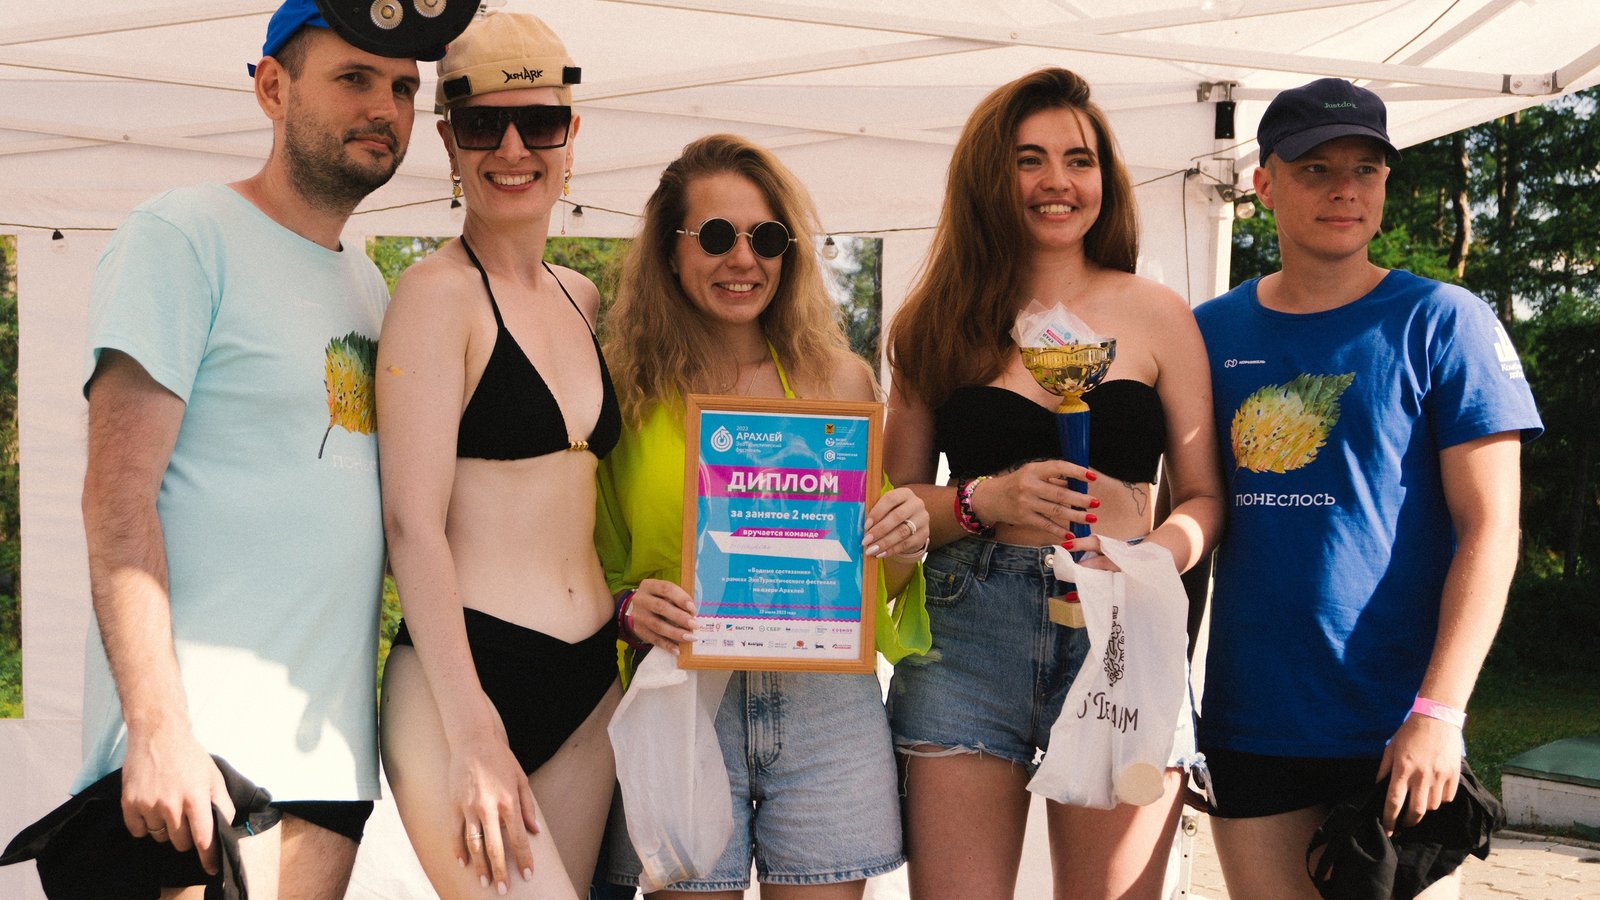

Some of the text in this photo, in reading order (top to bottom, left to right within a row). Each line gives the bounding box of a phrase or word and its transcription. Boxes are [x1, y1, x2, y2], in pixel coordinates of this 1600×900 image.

[736, 432, 783, 442] АРАХЛЕЙ
[727, 471, 839, 493] ДИПЛОМ
[1235, 493, 1336, 507] ПОНЕСЛОСЬ
[730, 509, 834, 521] за занятое 2 место
[743, 529, 819, 538] вручается команде
